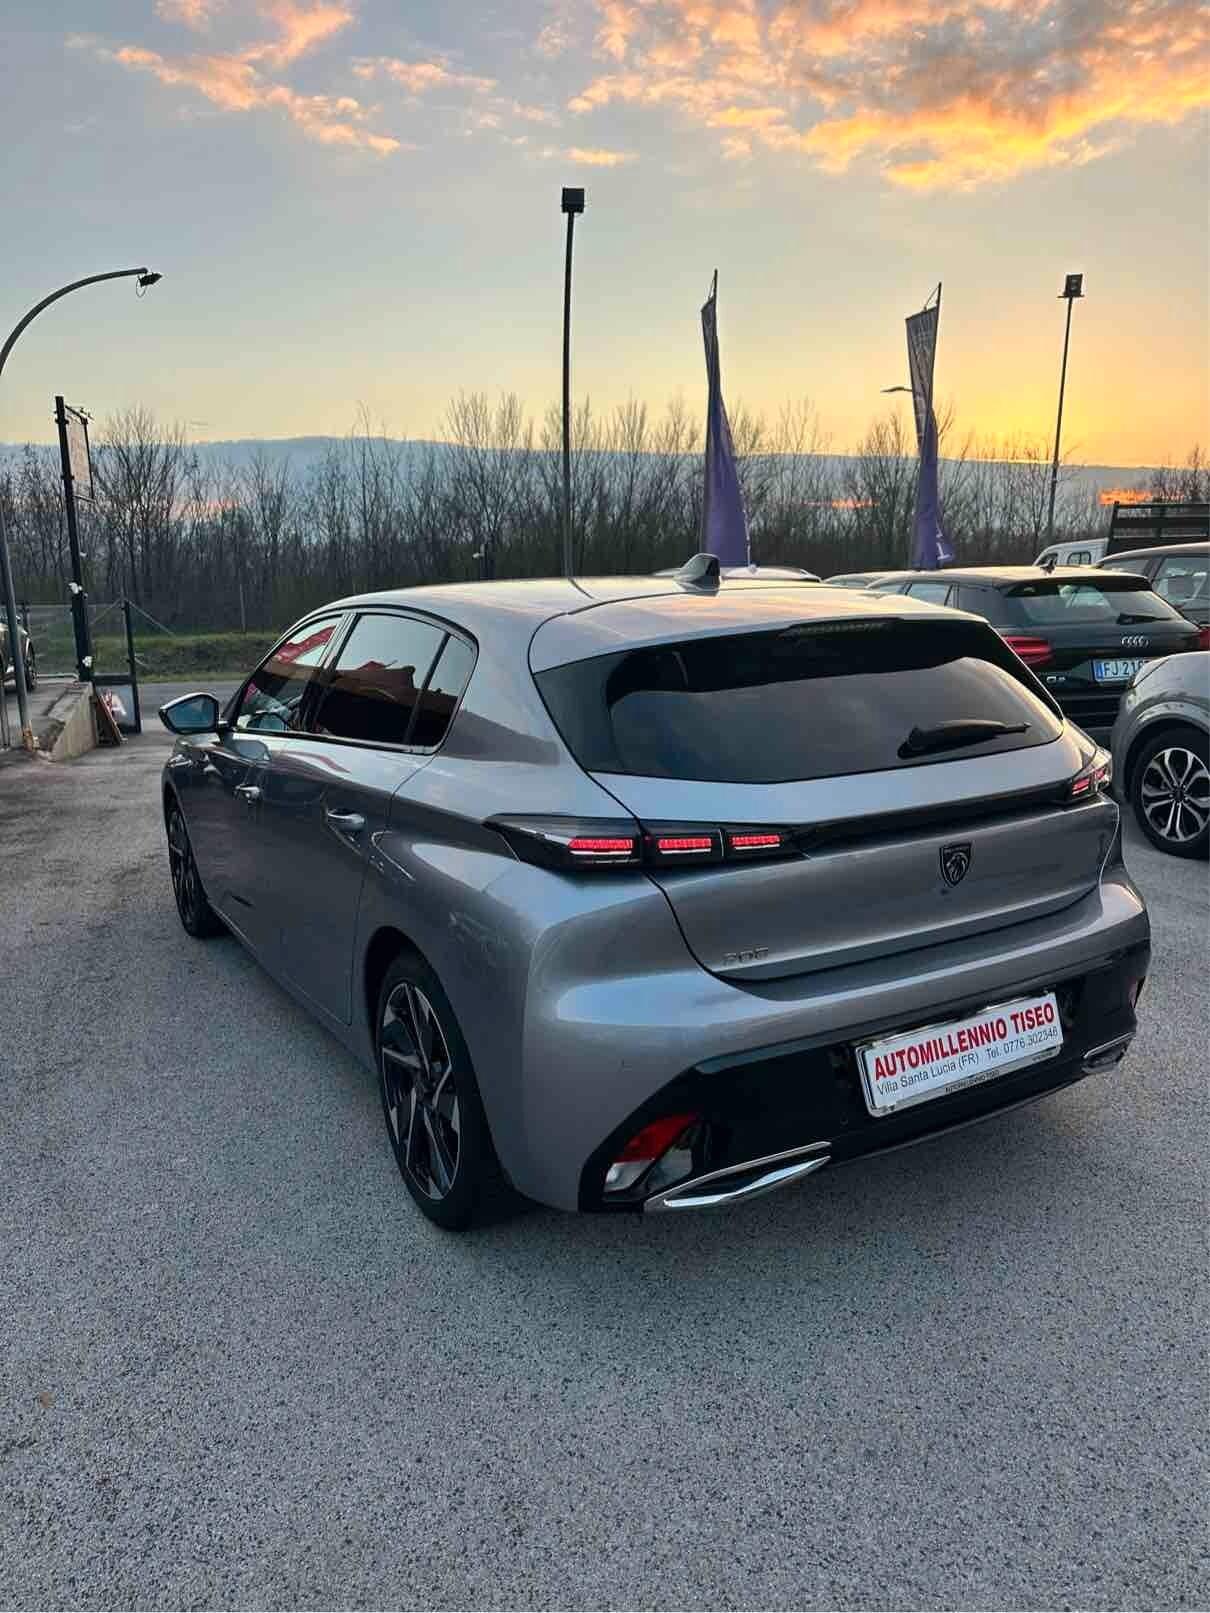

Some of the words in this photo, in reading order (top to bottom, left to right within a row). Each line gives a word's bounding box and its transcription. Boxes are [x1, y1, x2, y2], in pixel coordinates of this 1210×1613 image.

[874, 1018, 1007, 1080] AUTOMILLENNIO
[1010, 1003, 1055, 1034] TISEO
[877, 1080, 898, 1095] Villa
[900, 1070, 929, 1088] Santa
[931, 1062, 957, 1081] Lucia
[958, 1052, 979, 1071] (FR)
[1003, 1037, 1026, 1055] 0776
